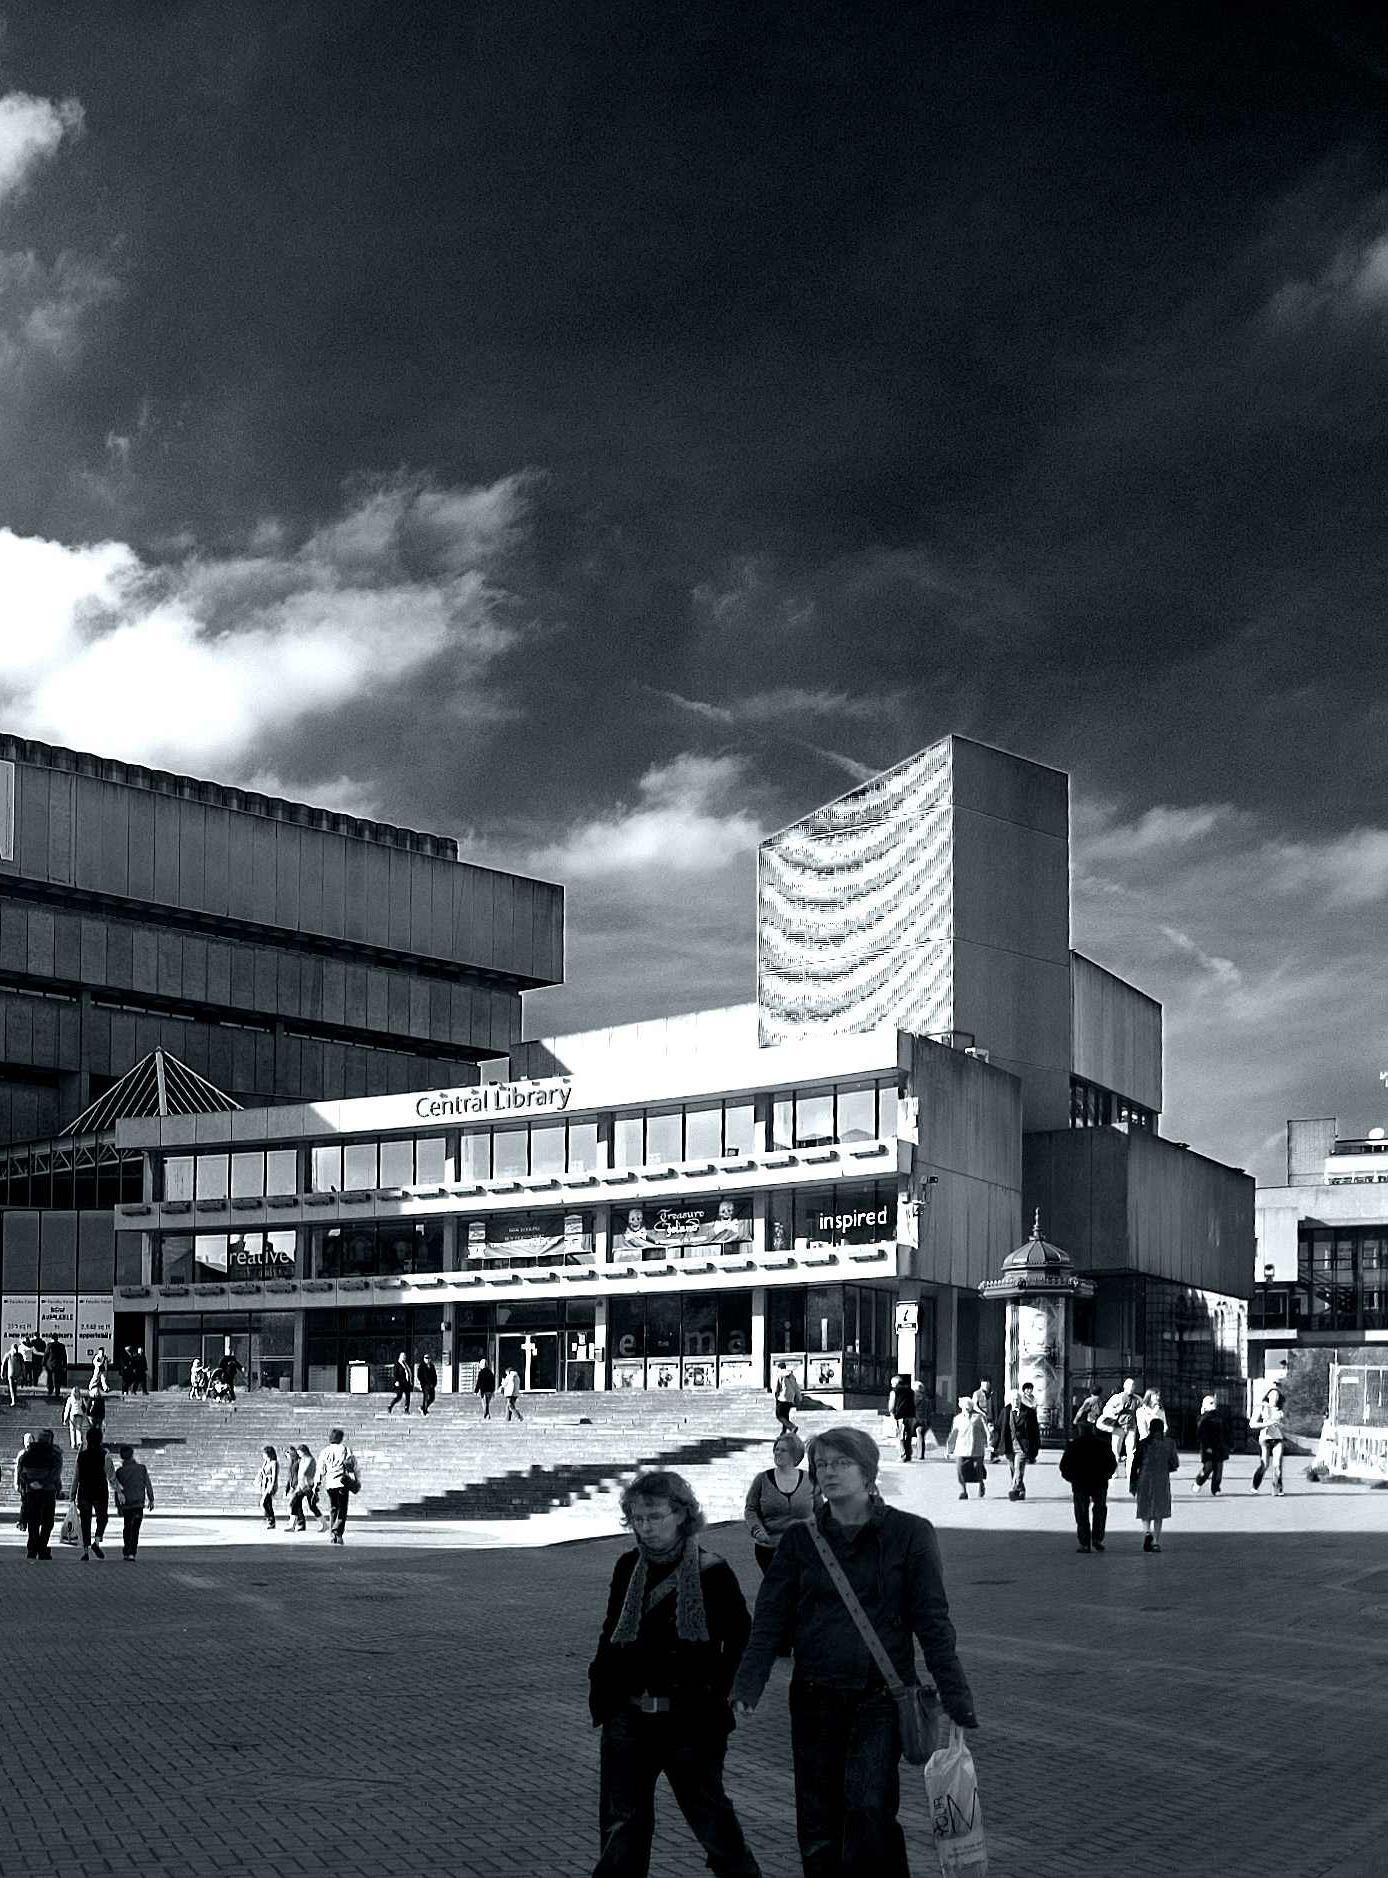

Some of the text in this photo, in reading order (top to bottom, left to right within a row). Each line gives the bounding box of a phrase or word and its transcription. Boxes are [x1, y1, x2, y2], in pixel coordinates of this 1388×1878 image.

[415, 1086, 573, 1118] Central Library
[819, 1205, 887, 1234] inspired
